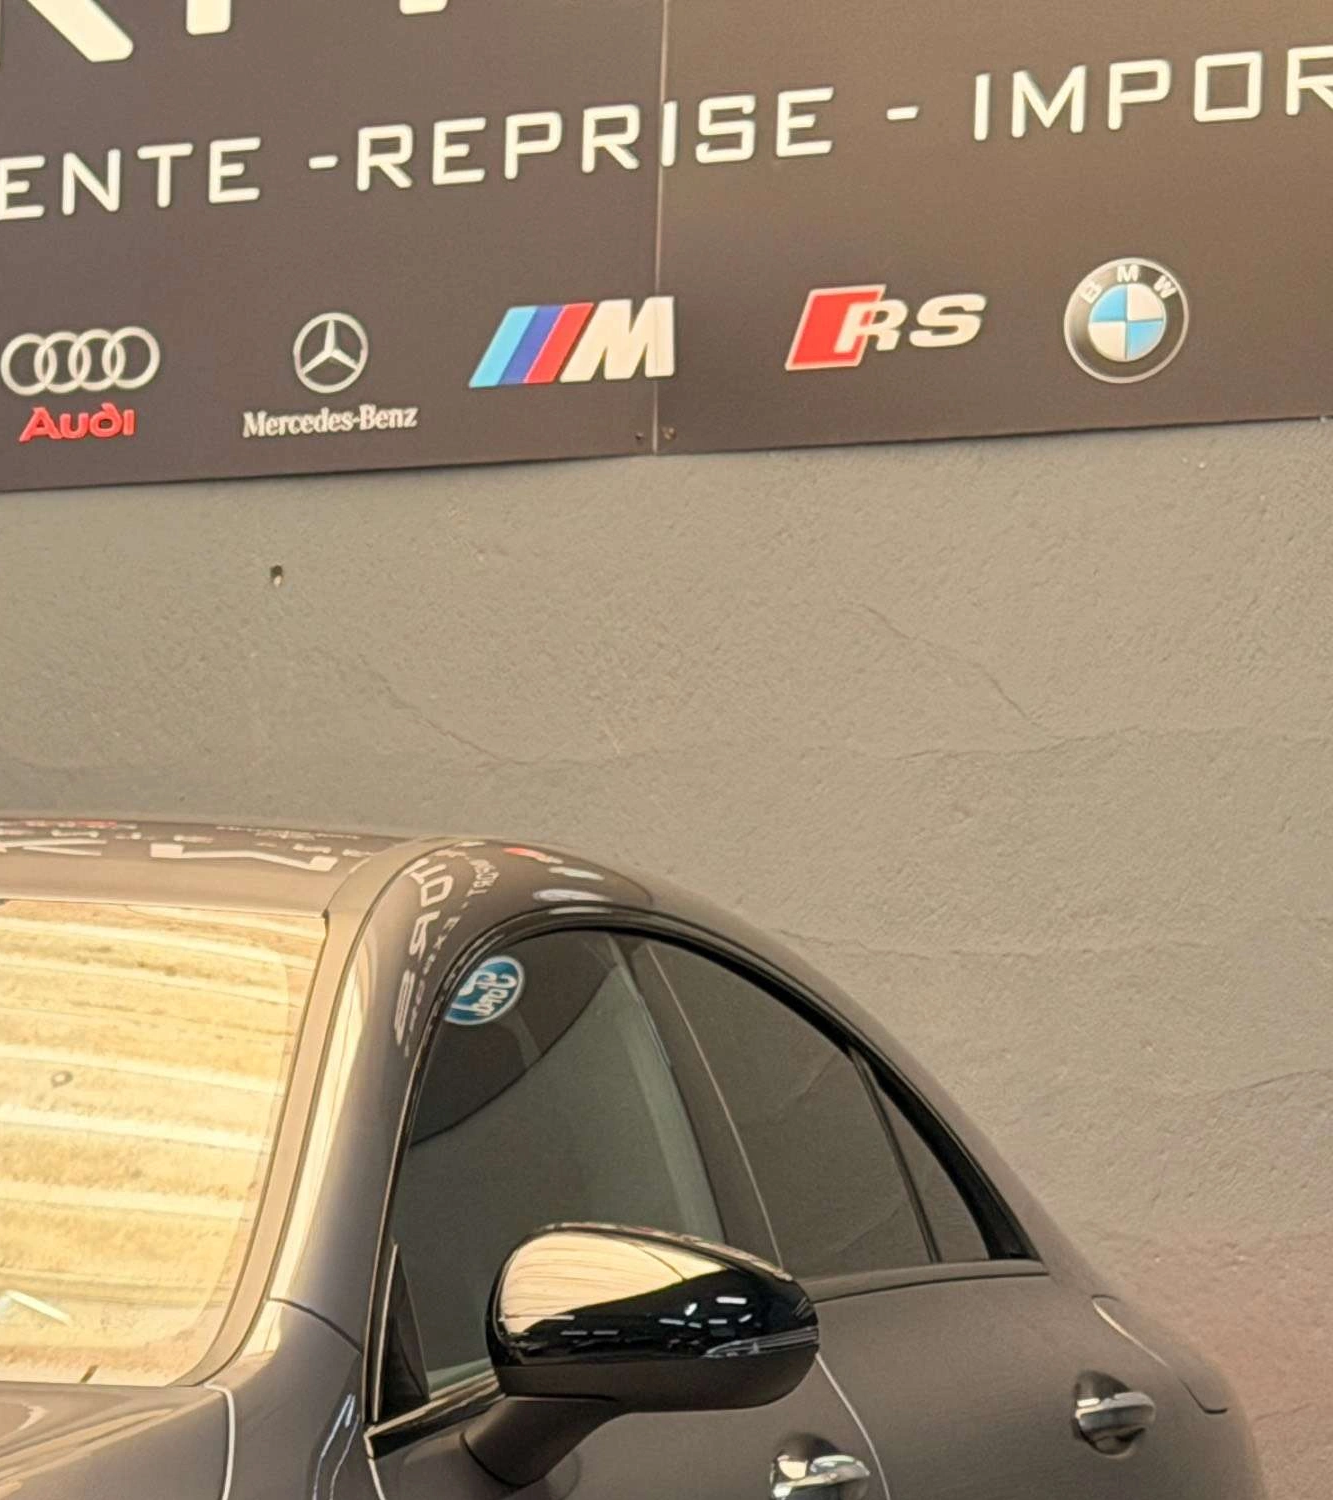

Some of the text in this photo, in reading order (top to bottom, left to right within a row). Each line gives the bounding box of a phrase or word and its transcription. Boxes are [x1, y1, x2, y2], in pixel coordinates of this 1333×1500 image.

[1079, 263, 1178, 305] BMW
[830, 290, 989, 357] RS
[19, 402, 135, 442] Audi
[242, 403, 418, 438] Mercedes-Benz
